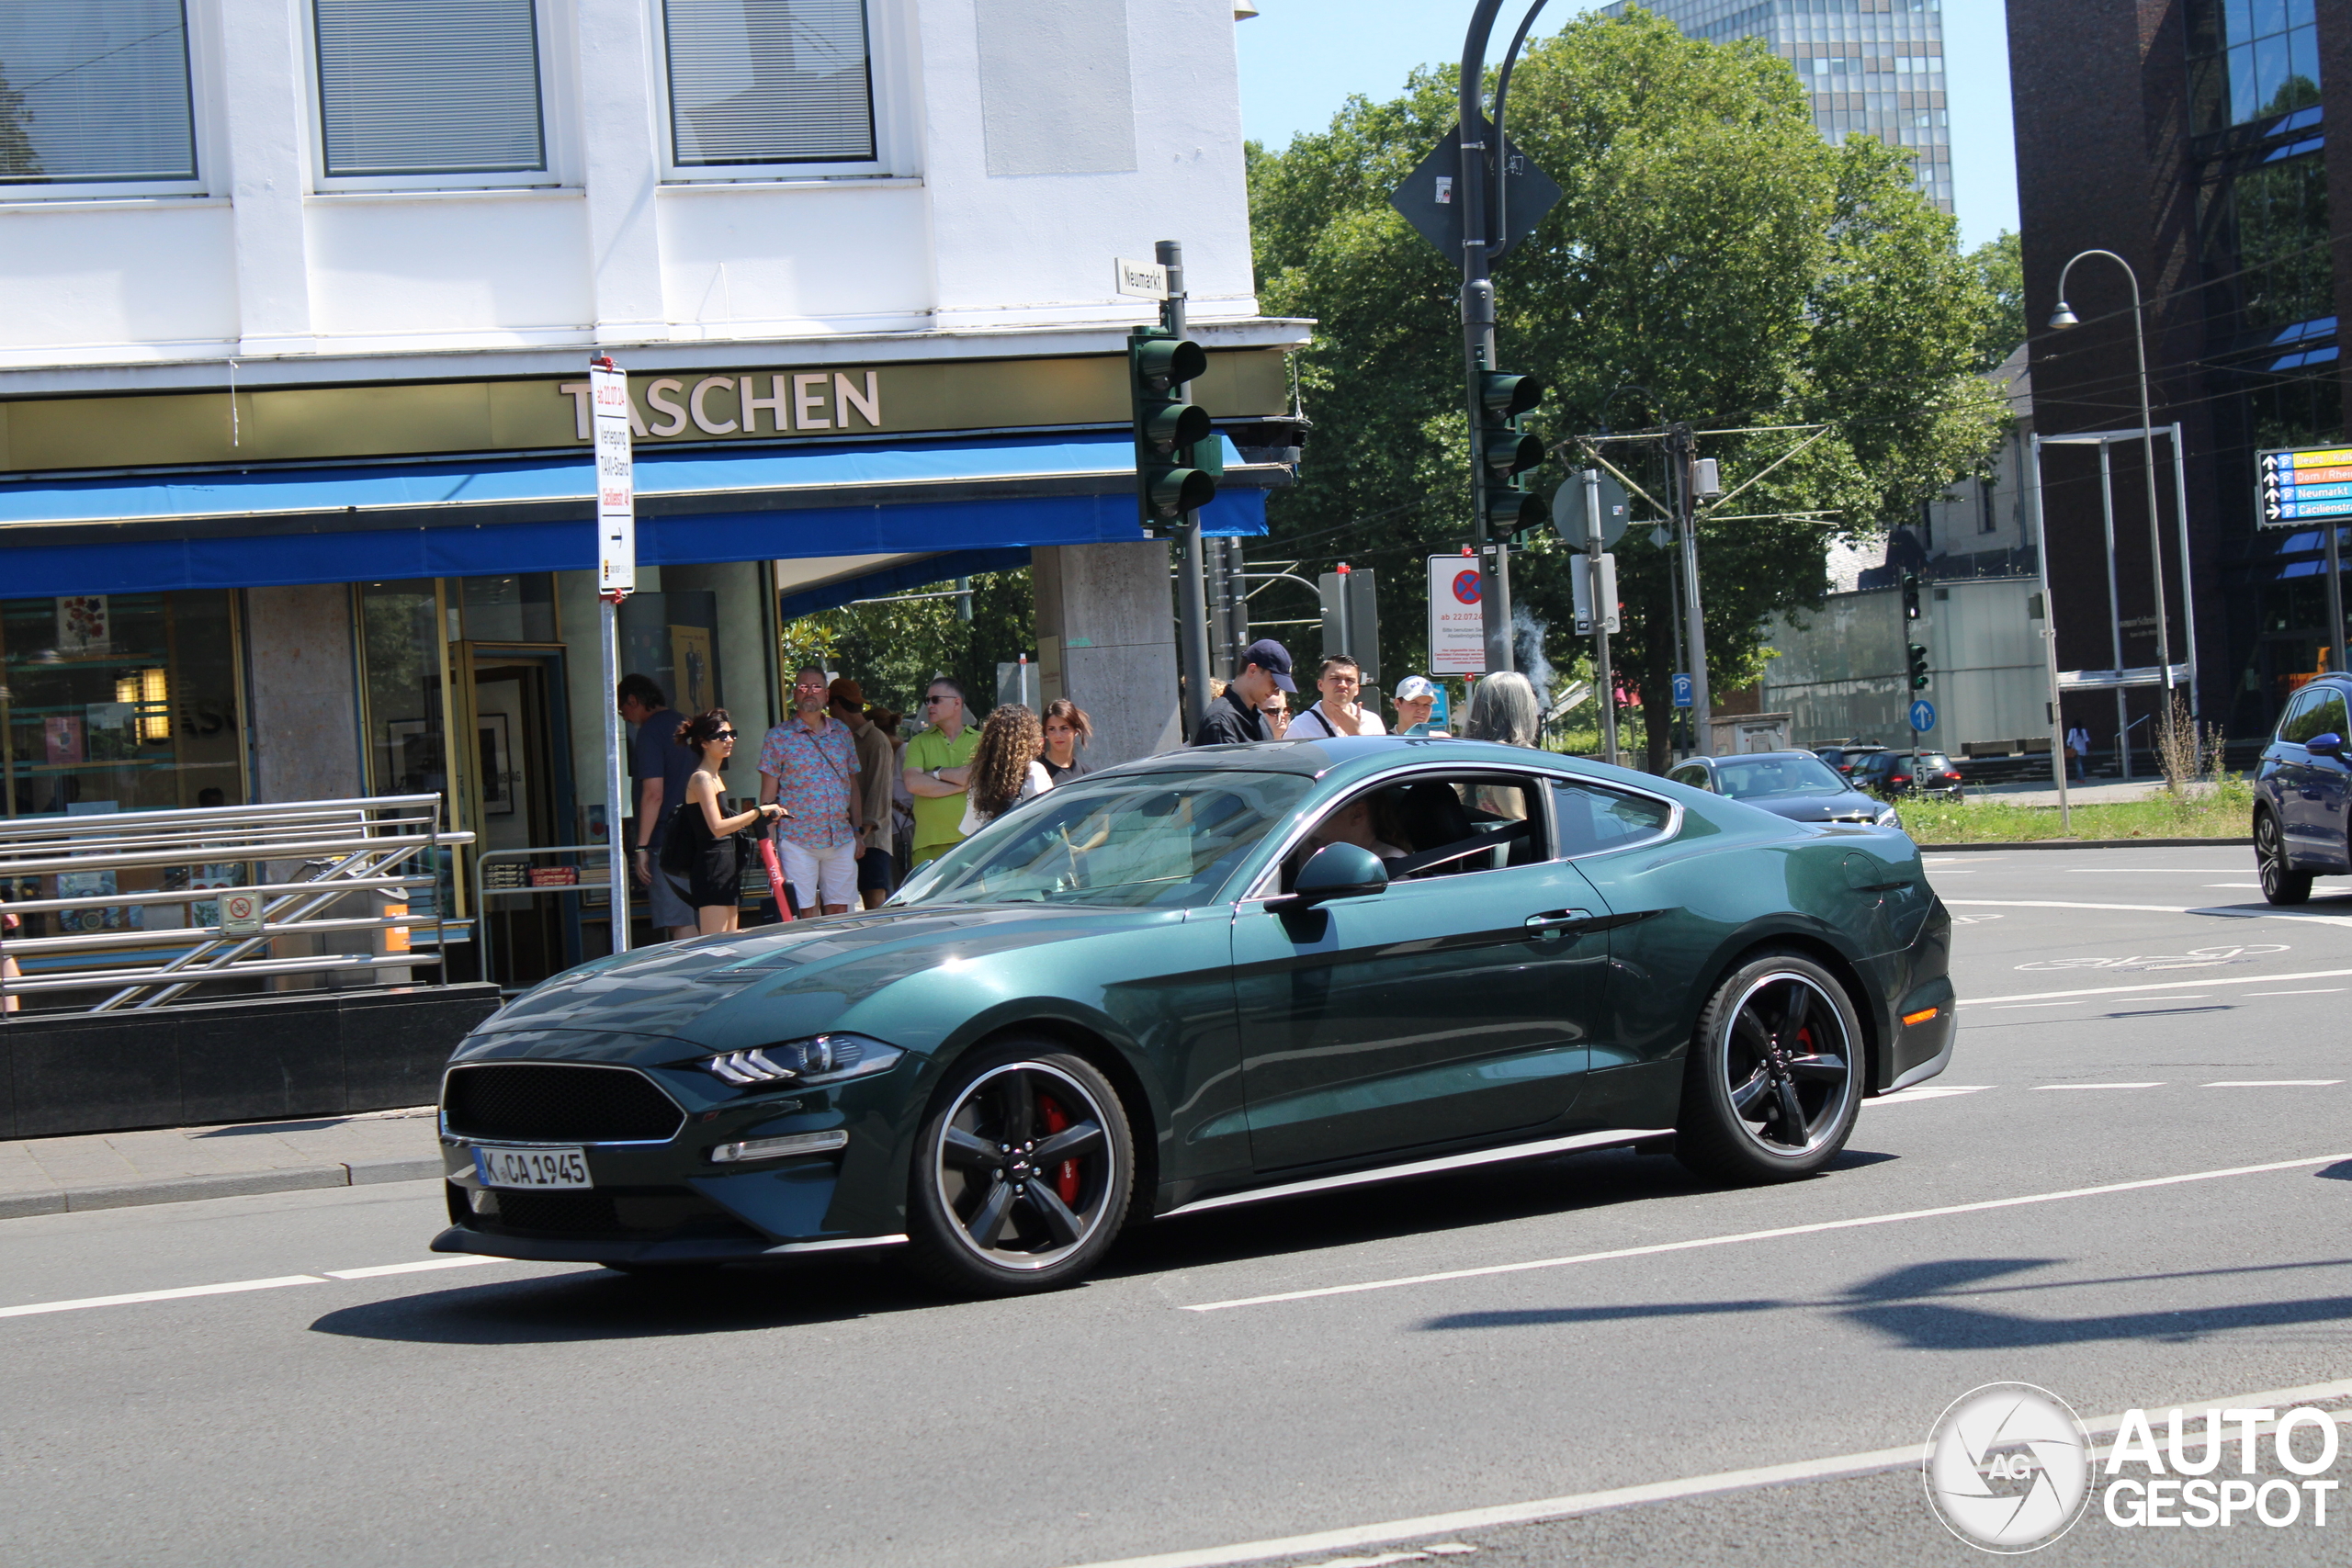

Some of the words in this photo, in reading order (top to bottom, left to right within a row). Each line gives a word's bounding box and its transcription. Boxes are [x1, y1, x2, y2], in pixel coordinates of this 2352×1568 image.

[1125, 265, 1162, 291] Neumarkt
[599, 424, 626, 450] Verlegung
[600, 455, 629, 476] TAXI-Stand
[2296, 455, 2324, 465] Deutz
[2297, 472, 2320, 482] Dom
[2298, 486, 2348, 498] Neumarkt
[1916, 767, 1924, 782] 5
[483, 1152, 499, 1182] K
[505, 1154, 532, 1184] CA
[532, 1154, 586, 1184] 1945
